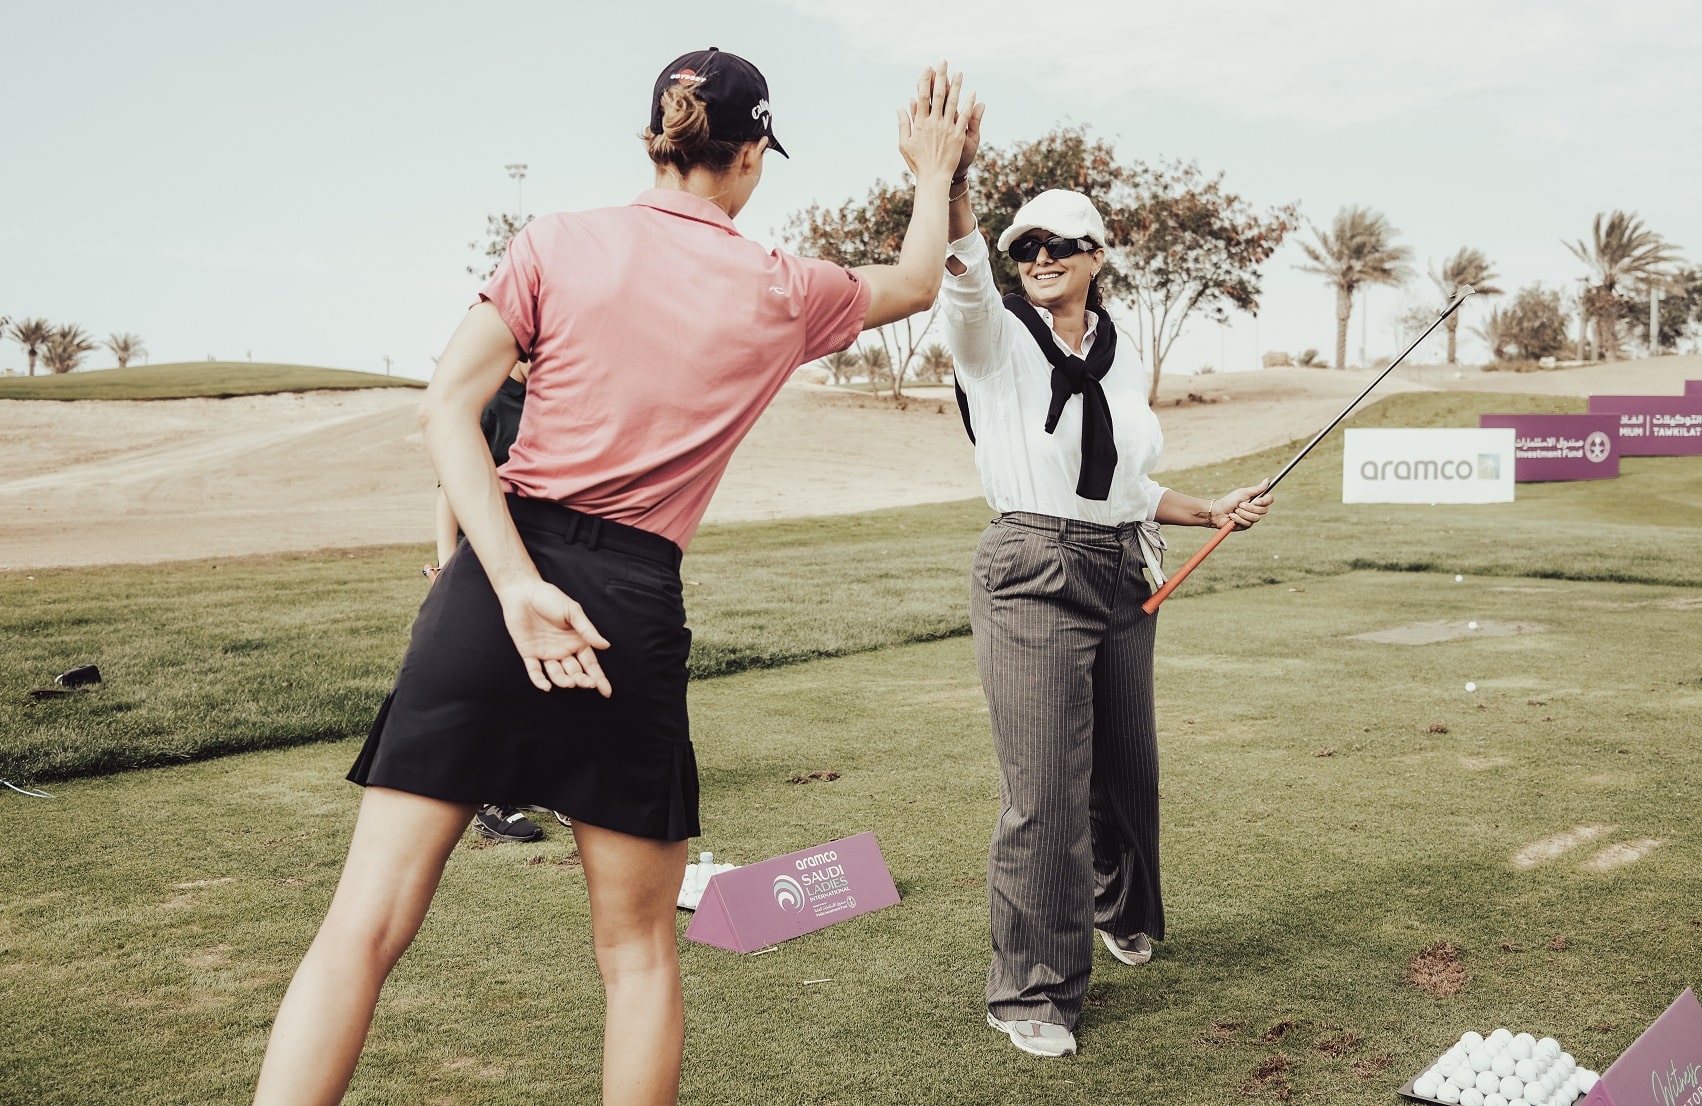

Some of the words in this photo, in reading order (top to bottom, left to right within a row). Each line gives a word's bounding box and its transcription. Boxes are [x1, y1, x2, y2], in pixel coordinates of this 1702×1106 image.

[1653, 427, 1702, 437] TAWKILAT
[1515, 449, 1562, 459] Investment
[1563, 448, 1584, 458] Fund
[1360, 460, 1473, 481] aramco
[795, 850, 838, 871] aramco
[801, 864, 845, 886] SAUDI
[806, 876, 848, 896] LADIES
[810, 886, 852, 902] INTERNATIONAL
